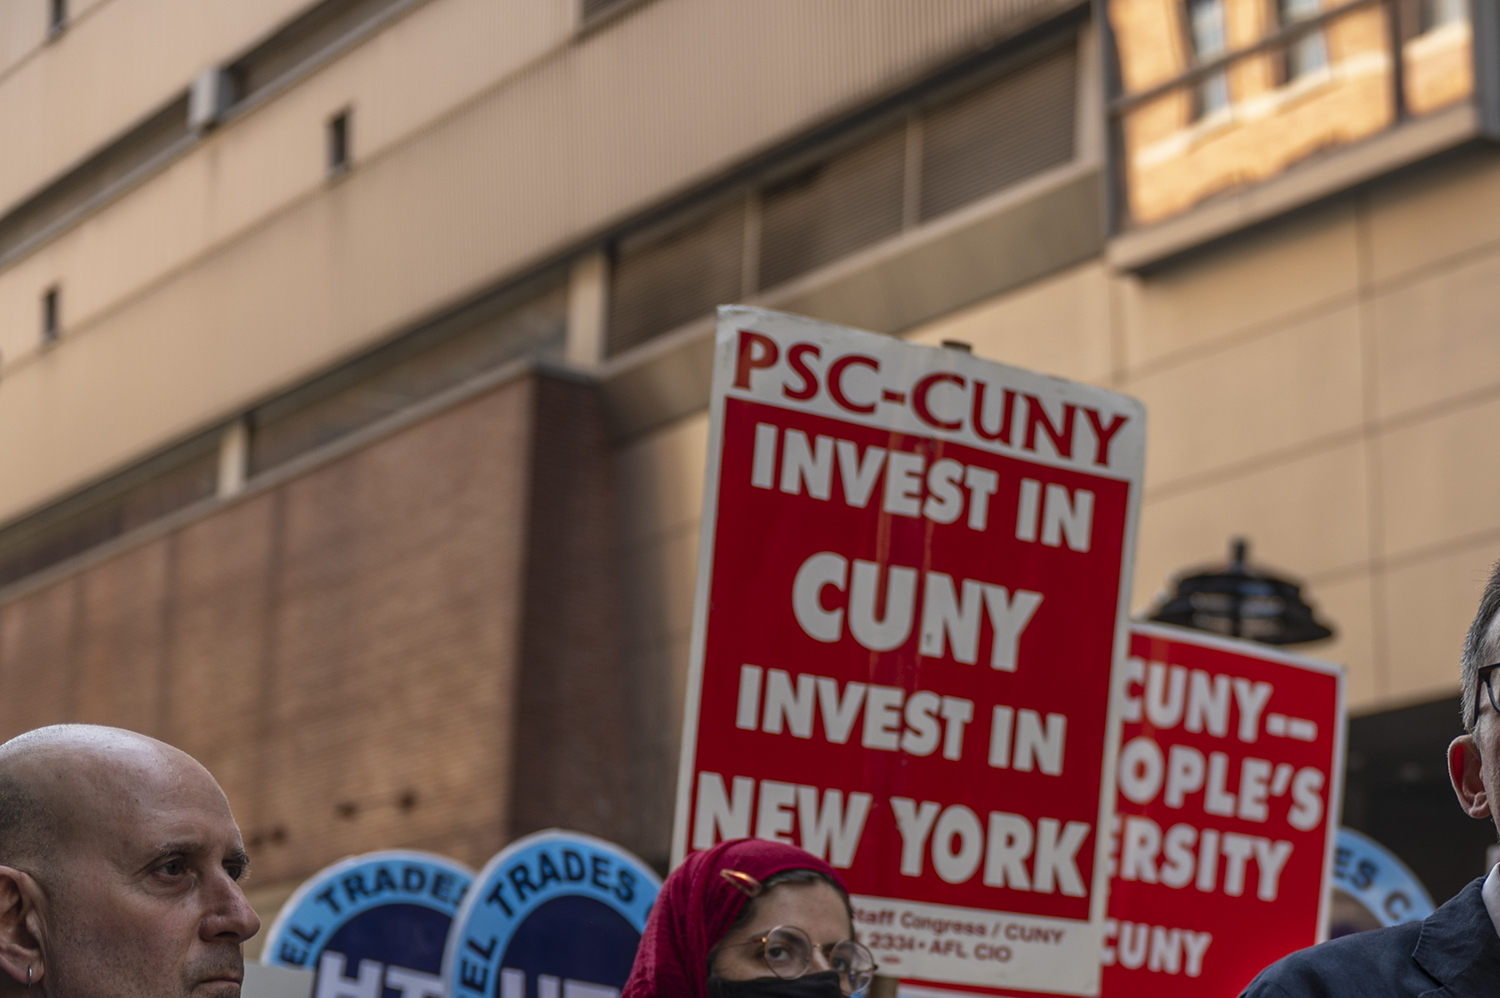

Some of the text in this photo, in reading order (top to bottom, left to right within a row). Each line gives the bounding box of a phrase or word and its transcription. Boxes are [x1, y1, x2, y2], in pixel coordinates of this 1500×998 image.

[731, 329, 1130, 468] PSC-CUNY
[751, 422, 1096, 553] INVEST IN
[791, 551, 1045, 672] CUNY
[736, 664, 1068, 777] INVEST IN
[486, 850, 637, 919] TRADES
[692, 771, 1092, 898] NEW YORK
[900, 911, 987, 937] Congress
[1004, 922, 1065, 945] CUNY
[928, 940, 967, 959] AFL
[974, 943, 1012, 963] CIO
